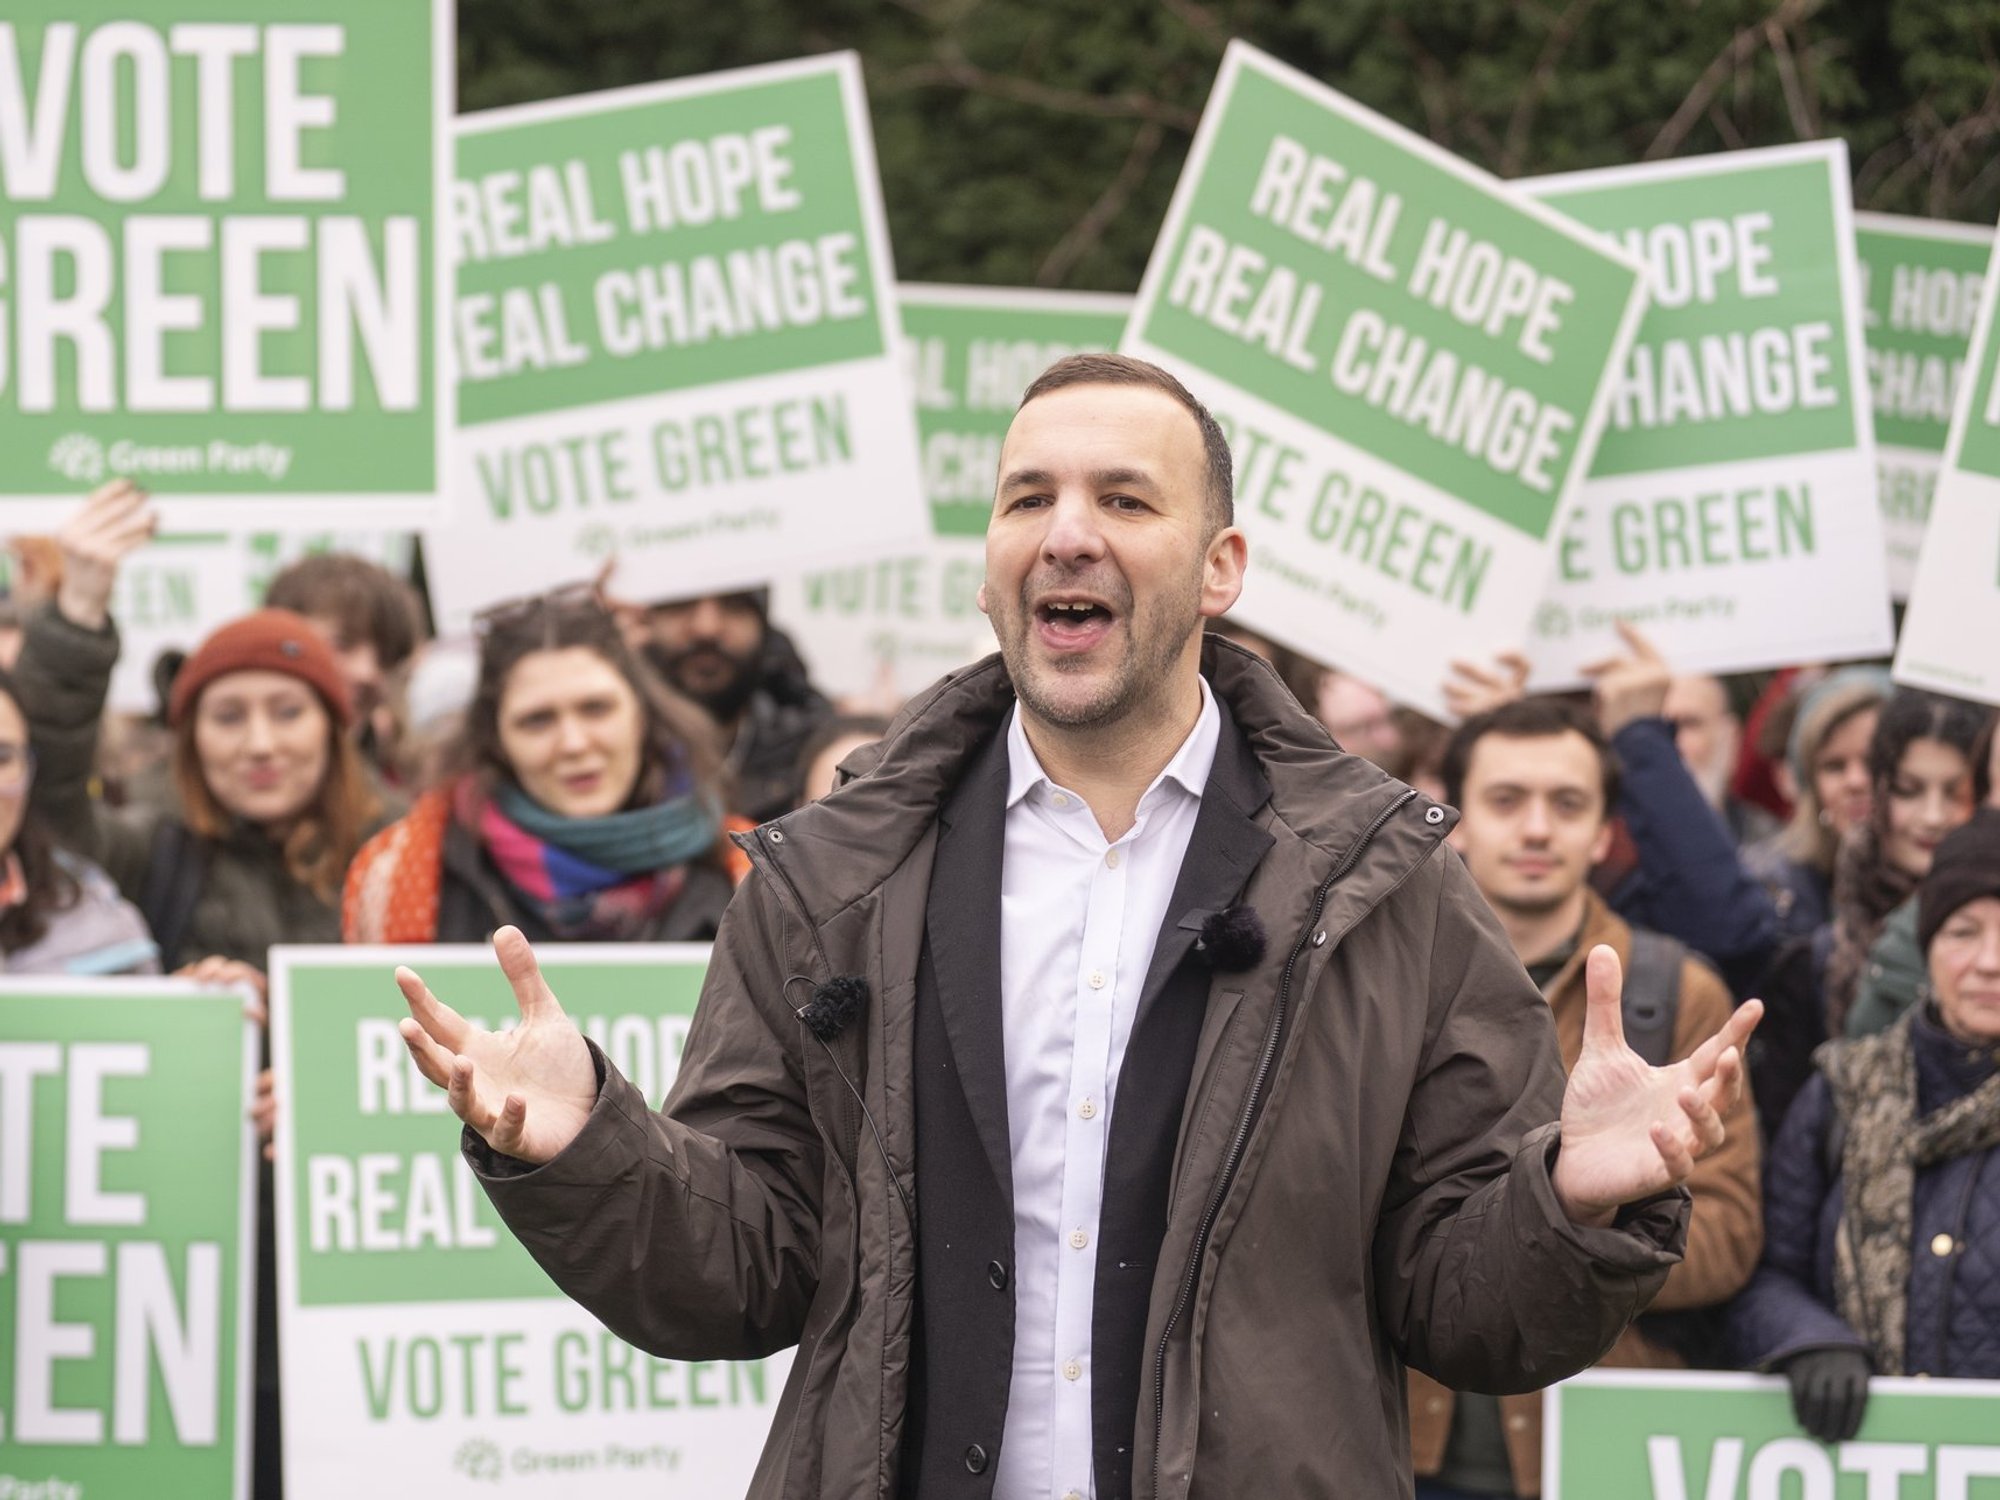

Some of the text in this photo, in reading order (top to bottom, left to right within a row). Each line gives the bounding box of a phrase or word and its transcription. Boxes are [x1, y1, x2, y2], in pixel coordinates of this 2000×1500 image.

[0, 20, 345, 202] VOTE
[452, 125, 802, 266] REAL HOPE
[1252, 136, 1575, 364] REAL HOPE
[0, 214, 419, 412] REEN
[455, 232, 868, 379] EAL CHANGE
[1168, 225, 1577, 493] REAL CHANGE
[1890, 263, 1985, 339] HOP
[1612, 320, 1838, 430] HANGE
[108, 438, 292, 482] Green Party
[474, 427, 636, 521] VOTE
[651, 390, 855, 497] GREEN
[1306, 467, 1494, 616] GREEN
[1611, 482, 1816, 576] GREEN
[0, 1042, 151, 1227] TE
[309, 1152, 497, 1252] REAL
[356, 1328, 769, 1421] VOTE GREEN
[510, 1442, 683, 1475] Green Party
